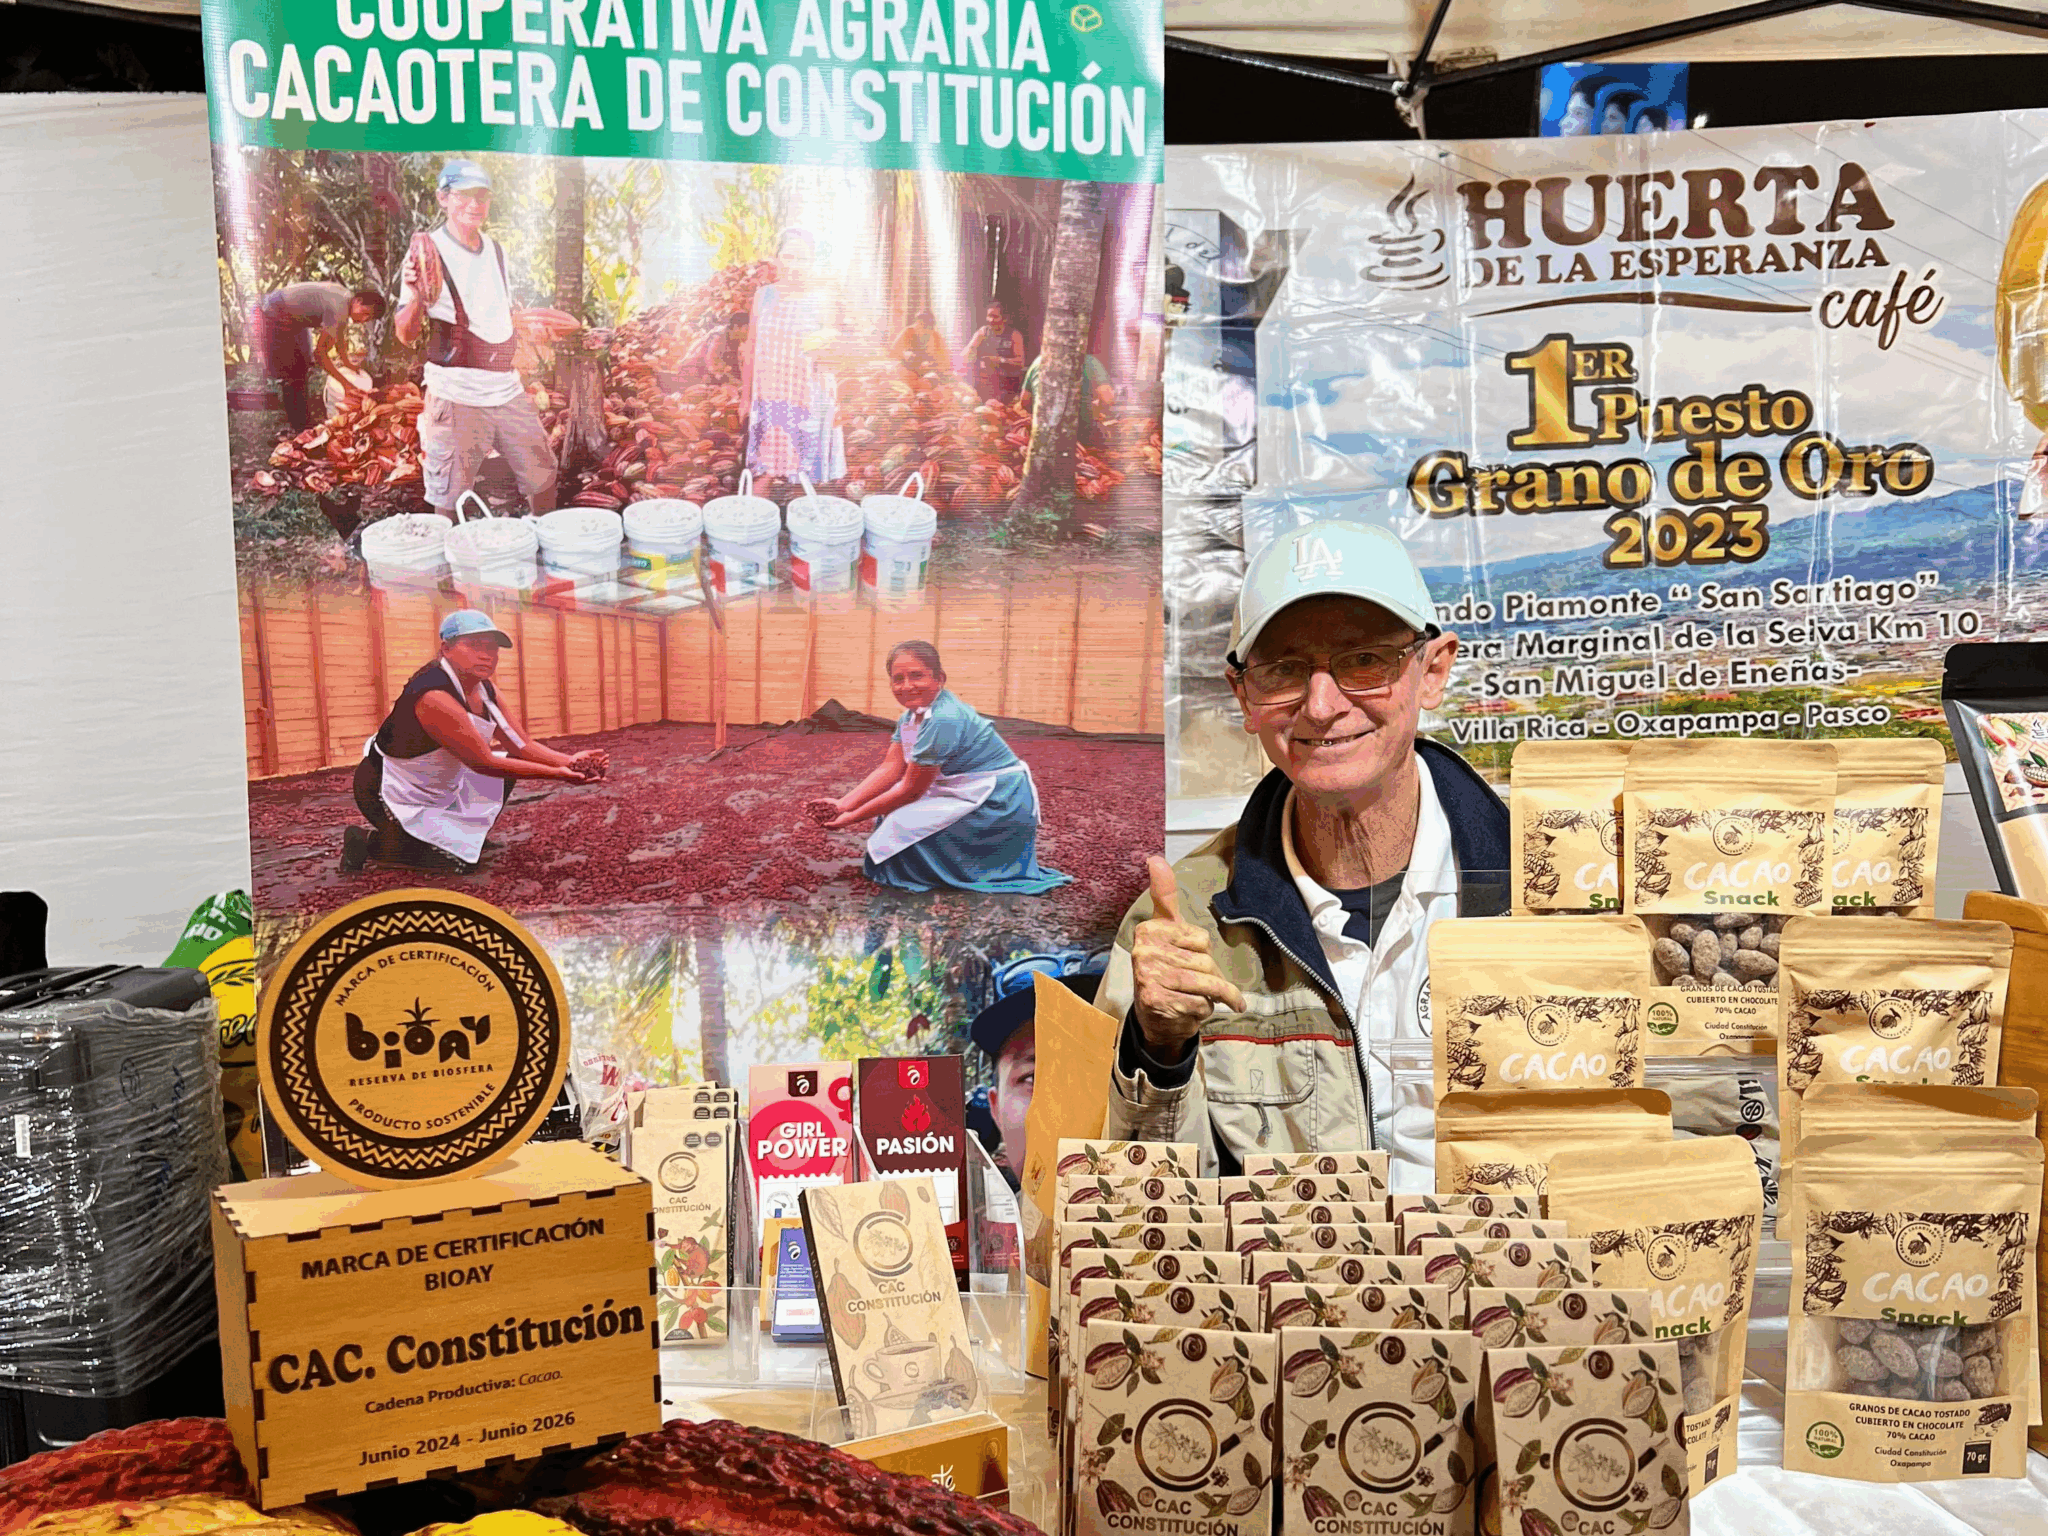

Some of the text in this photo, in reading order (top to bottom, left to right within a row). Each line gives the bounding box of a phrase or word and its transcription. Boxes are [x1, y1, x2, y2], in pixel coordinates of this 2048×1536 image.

[338, 0, 1050, 72] COOPERATIVA AGRARIA
[229, 43, 1147, 158] CACAOTERA DE CONSTITUCIÓN
[1455, 162, 1896, 249] HUERTA
[1466, 237, 1890, 288] DE LA ESPERANZA
[1818, 269, 1944, 349] café
[1597, 386, 1811, 442] Puesto
[1410, 434, 1932, 516] Grano de Oro
[1606, 506, 1769, 568] 2023
[1292, 532, 1344, 582] LA
[1438, 594, 1499, 624] ndo
[1506, 592, 1658, 621] Piamonte
[1702, 584, 1769, 610] San
[1456, 611, 1979, 666] era Marginal de la Selva Km 10
[1554, 666, 1666, 699] Miguel
[1678, 665, 1717, 689] de
[1452, 716, 1517, 744] Villa
[1525, 711, 1587, 739] Rica
[1616, 709, 1779, 739] Oxapampa
[1807, 704, 1889, 728] Pasco
[1684, 859, 1791, 891] CACAO
[1832, 860, 1892, 885] CAO
[1704, 890, 1779, 907] Snack
[1832, 890, 1877, 907] ack
[335, 950, 495, 1007] MARCA DE CERTIFICACIÓN
[1420, 983, 1431, 1021] AGRA
[1686, 996, 1778, 1005] CUBIERTO EN CHOCOLATE
[1734, 1007, 1757, 1015] CACAO
[1499, 1052, 1606, 1083] CACAO
[1840, 1045, 1951, 1074] CACAO
[349, 1064, 494, 1087] RESERVA DE BIOSFERA
[348, 1082, 496, 1131] PRODUCTO SOSTENIBLE
[779, 1121, 826, 1139] GIRL
[757, 1137, 848, 1160] POWER
[876, 1132, 955, 1156] PASIÓN
[653, 1203, 711, 1214] ONSTITUCIÓN
[669, 1197, 688, 1205] CAC
[301, 1218, 604, 1280] MARCA DE CERTIFICACIÓN
[424, 1264, 494, 1292] BIOAY
[878, 1281, 906, 1294] CAC
[1862, 1272, 1989, 1303] CACAO
[847, 1291, 941, 1313] CONSTITUCIÓN
[1650, 1281, 1725, 1318] ACAO
[1655, 1317, 1712, 1340] nack
[1881, 1307, 1969, 1327] Snack
[268, 1299, 645, 1393] CAC. Constitución
[364, 1368, 563, 1414] Cadena Productiva: Cacao.
[1849, 1403, 1971, 1418] GRANOS DE CACAO TOSTADO
[1855, 1416, 1964, 1430] CUBIERTO EN CHOCOLATE
[360, 1444, 411, 1466] Junio
[416, 1434, 461, 1455] 2024
[481, 1421, 528, 1444] Junio
[533, 1411, 575, 1433] 2026
[1814, 1428, 1838, 1438] 100%
[1886, 1431, 1936, 1441] 70% CACAO
[1874, 1446, 1947, 1457] Ciudad Constitución
[1890, 1459, 1932, 1469] Oxapampa
[1966, 1452, 1977, 1461] 70
[1155, 1499, 1192, 1515] CAC
[1361, 1501, 1398, 1517] CAC
[1107, 1512, 1239, 1536] CONSTITUCIÓN
[1314, 1518, 1445, 1536] CONSTITUCIÓN
[1578, 1520, 1615, 1536] CAC
